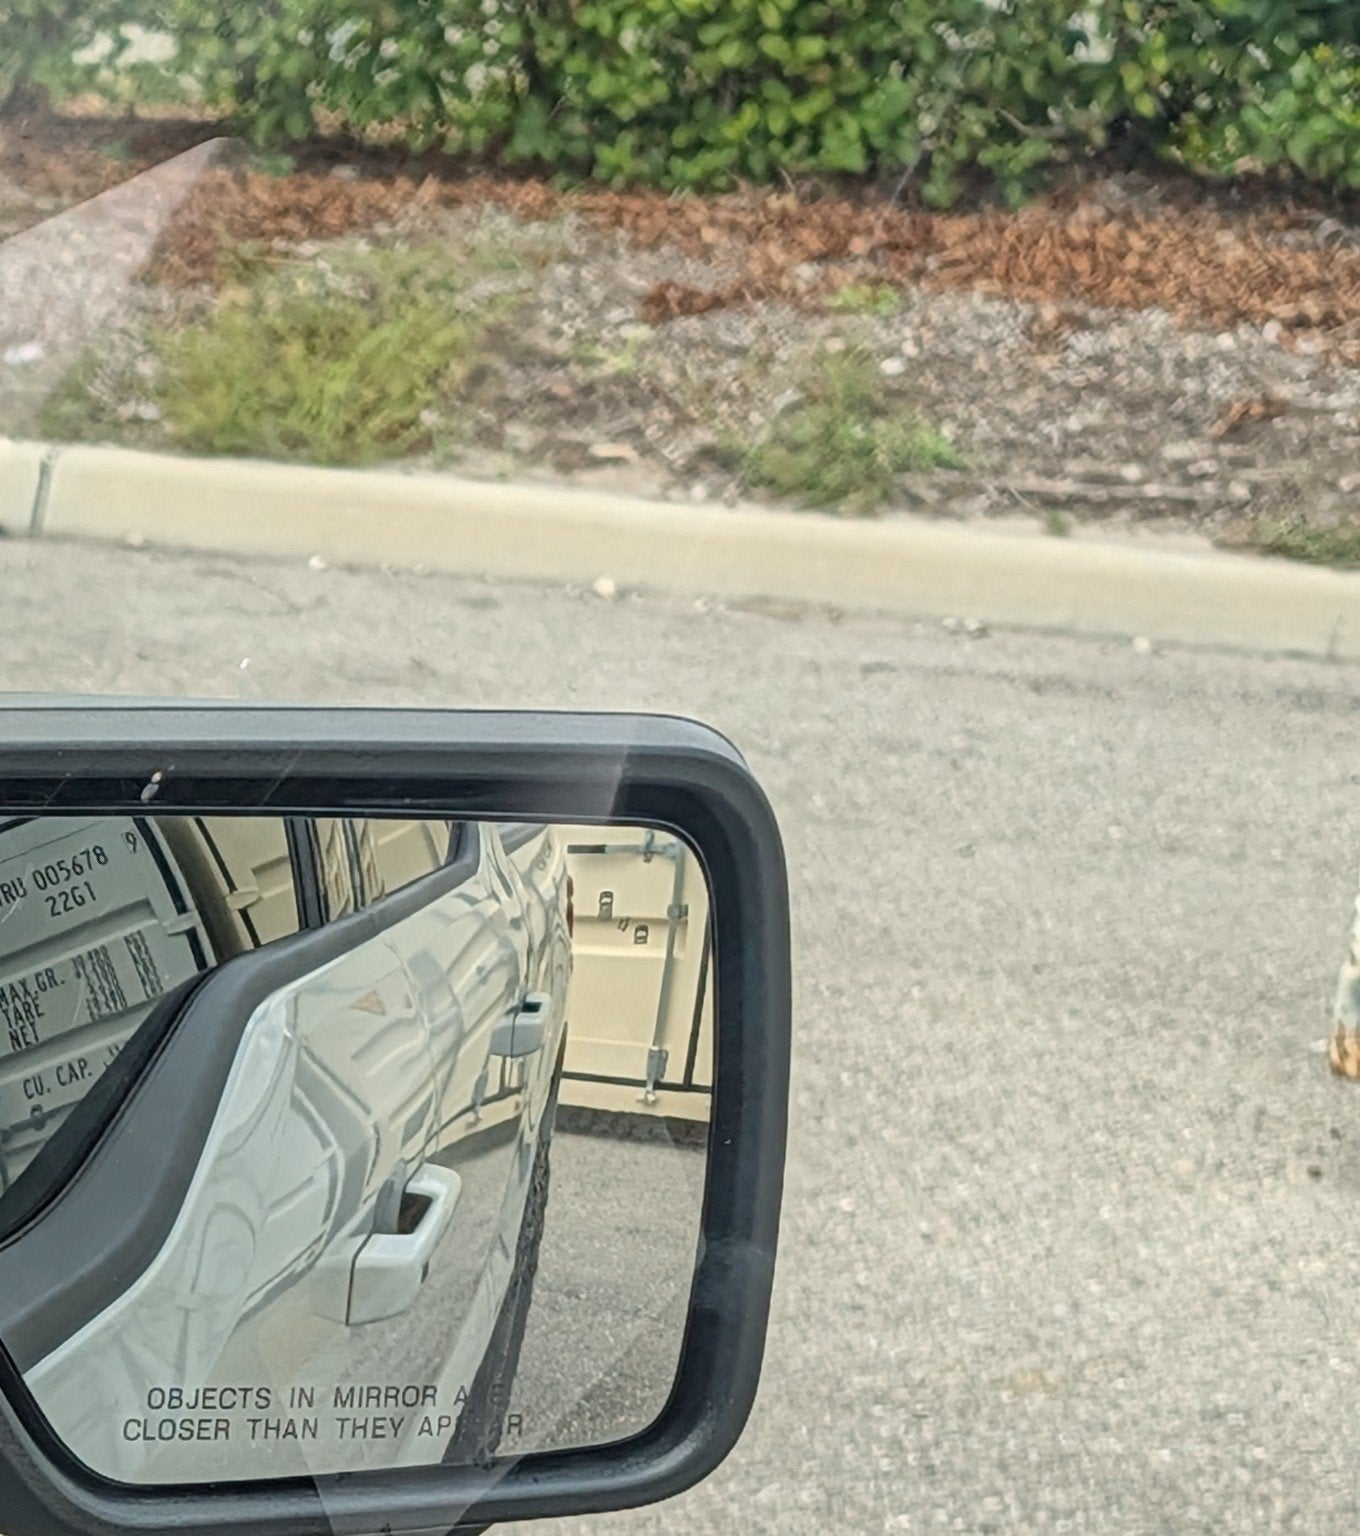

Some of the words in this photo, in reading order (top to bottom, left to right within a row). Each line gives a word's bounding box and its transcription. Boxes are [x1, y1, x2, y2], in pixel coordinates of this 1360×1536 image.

[32, 845, 109, 891] 005678
[45, 881, 98, 917] 22G1
[8, 1022, 40, 1051] NET
[147, 1387, 272, 1410] OBJECTS
[289, 1387, 315, 1409] IN
[333, 1385, 438, 1408] MIRROR
[453, 1384, 507, 1406] AE
[122, 1418, 231, 1442] CLOSER
[246, 1418, 318, 1440] THAN
[334, 1417, 405, 1440] THEY
